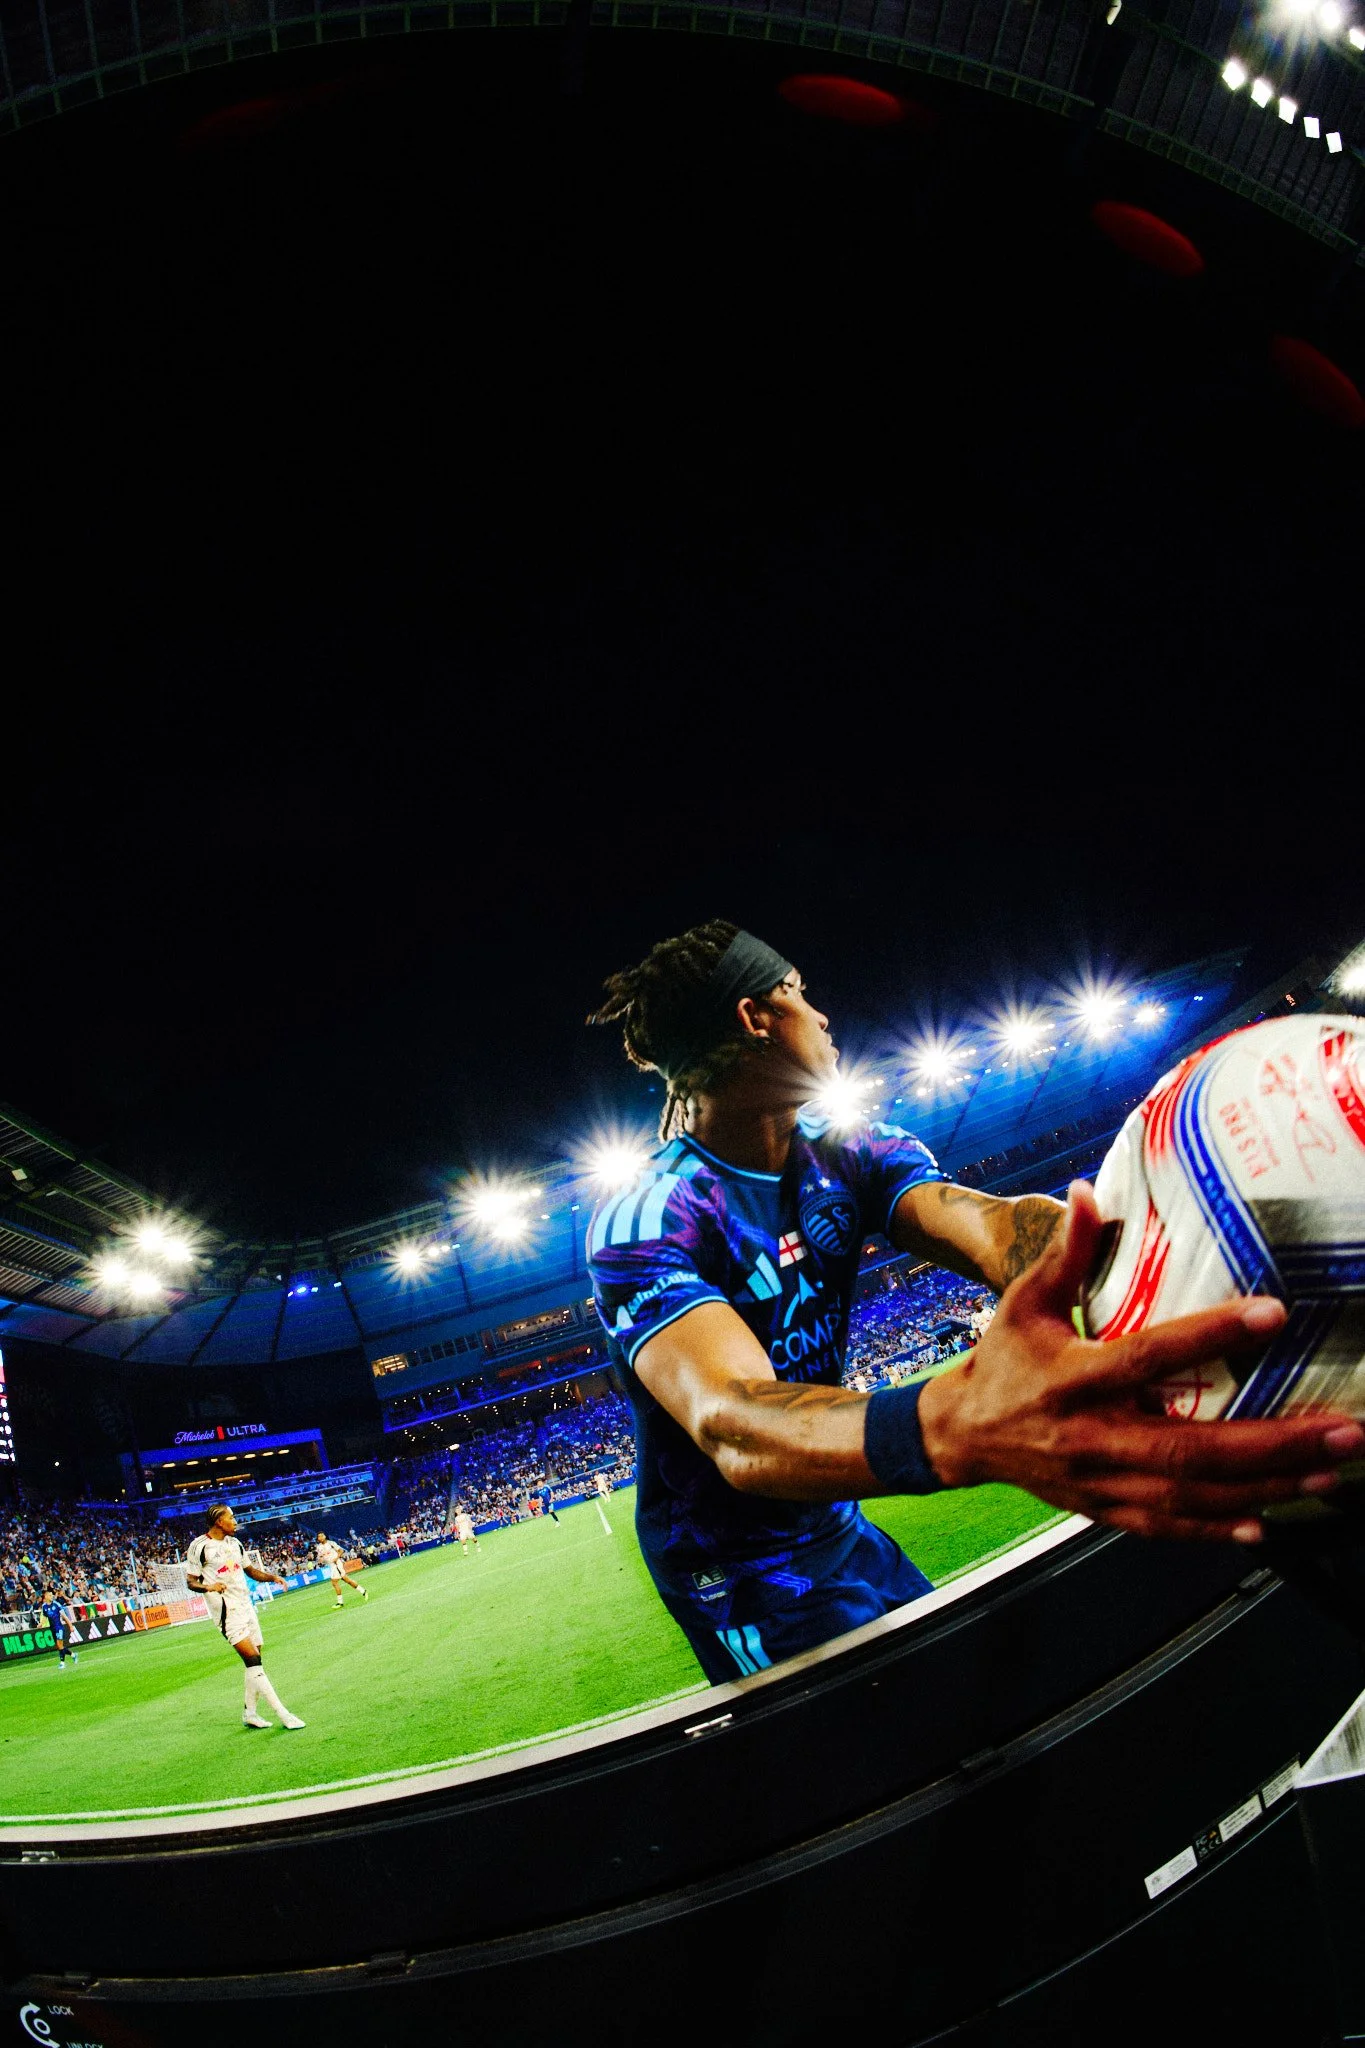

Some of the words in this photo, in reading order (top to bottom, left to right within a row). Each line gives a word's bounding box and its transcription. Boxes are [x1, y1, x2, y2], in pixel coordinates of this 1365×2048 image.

[174, 1430, 215, 1444] Michelob
[226, 1423, 266, 1437] ULTRA
[2, 1633, 34, 1655] MLS
[47, 2005, 74, 2016] LOCK
